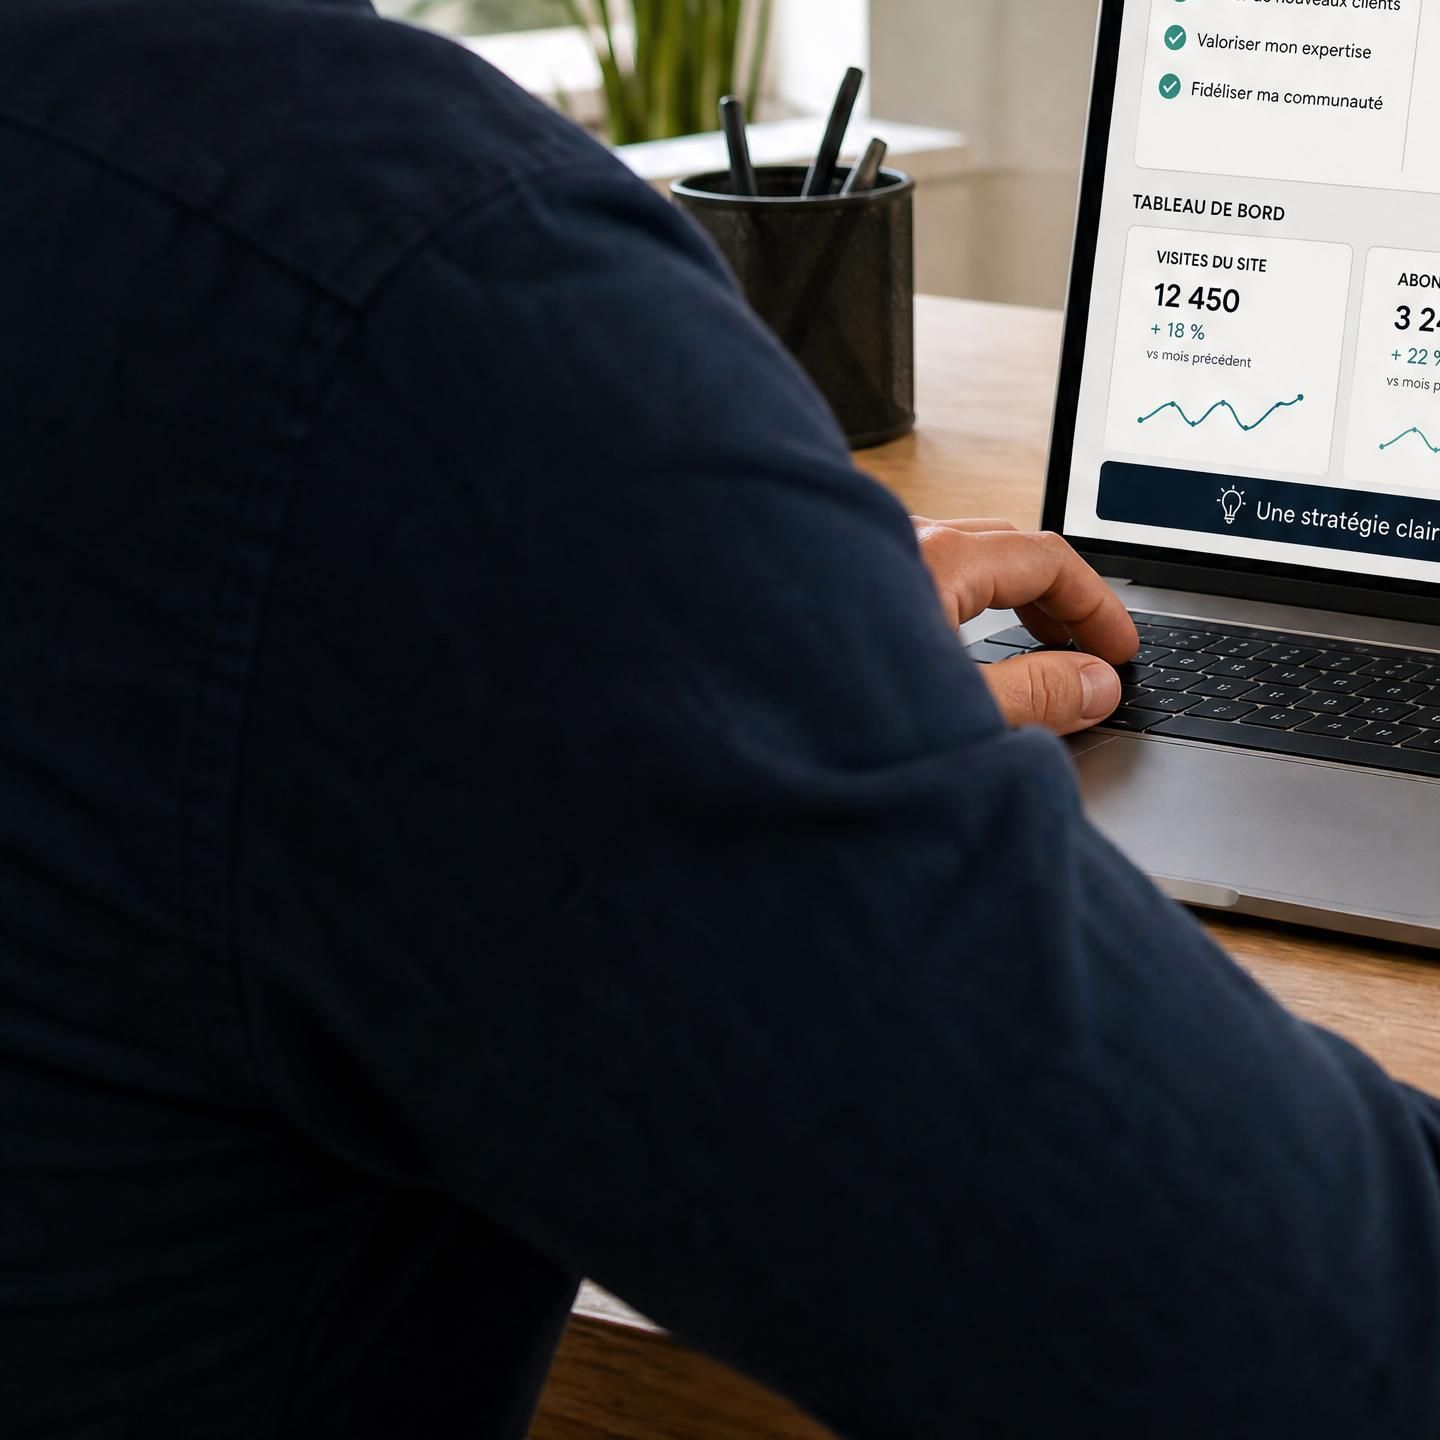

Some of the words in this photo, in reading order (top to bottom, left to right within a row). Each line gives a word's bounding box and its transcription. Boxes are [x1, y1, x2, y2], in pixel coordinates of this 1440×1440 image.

[1197, 32, 1262, 51] Valoriser
[1264, 41, 1298, 54] mon
[1302, 43, 1372, 60] expertise
[1191, 81, 1253, 100] Fidéliser
[1256, 90, 1279, 103] ma
[1283, 92, 1384, 111] communauté
[1132, 193, 1206, 215] TABLEAU
[1210, 200, 1233, 217] DE
[1237, 202, 1285, 221] BORD
[1156, 250, 1209, 268] VISITES
[1212, 255, 1234, 270] DU
[1236, 256, 1268, 273] SITE
[1154, 282, 1181, 308] 12
[1187, 286, 1240, 314] 450
[1394, 304, 1411, 331] 3
[1150, 323, 1161, 335] +
[1167, 322, 1185, 339] 18
[1190, 323, 1205, 341] %
[1146, 349, 1159, 360] vs
[1161, 350, 1190, 363] mois
[1191, 352, 1252, 369] précédent
[1391, 349, 1402, 361] +
[1407, 347, 1428, 366] 22
[1386, 377, 1399, 387] vs
[1402, 377, 1430, 390] mois
[1256, 500, 1296, 524] Une
[1300, 508, 1390, 538] stratégie
